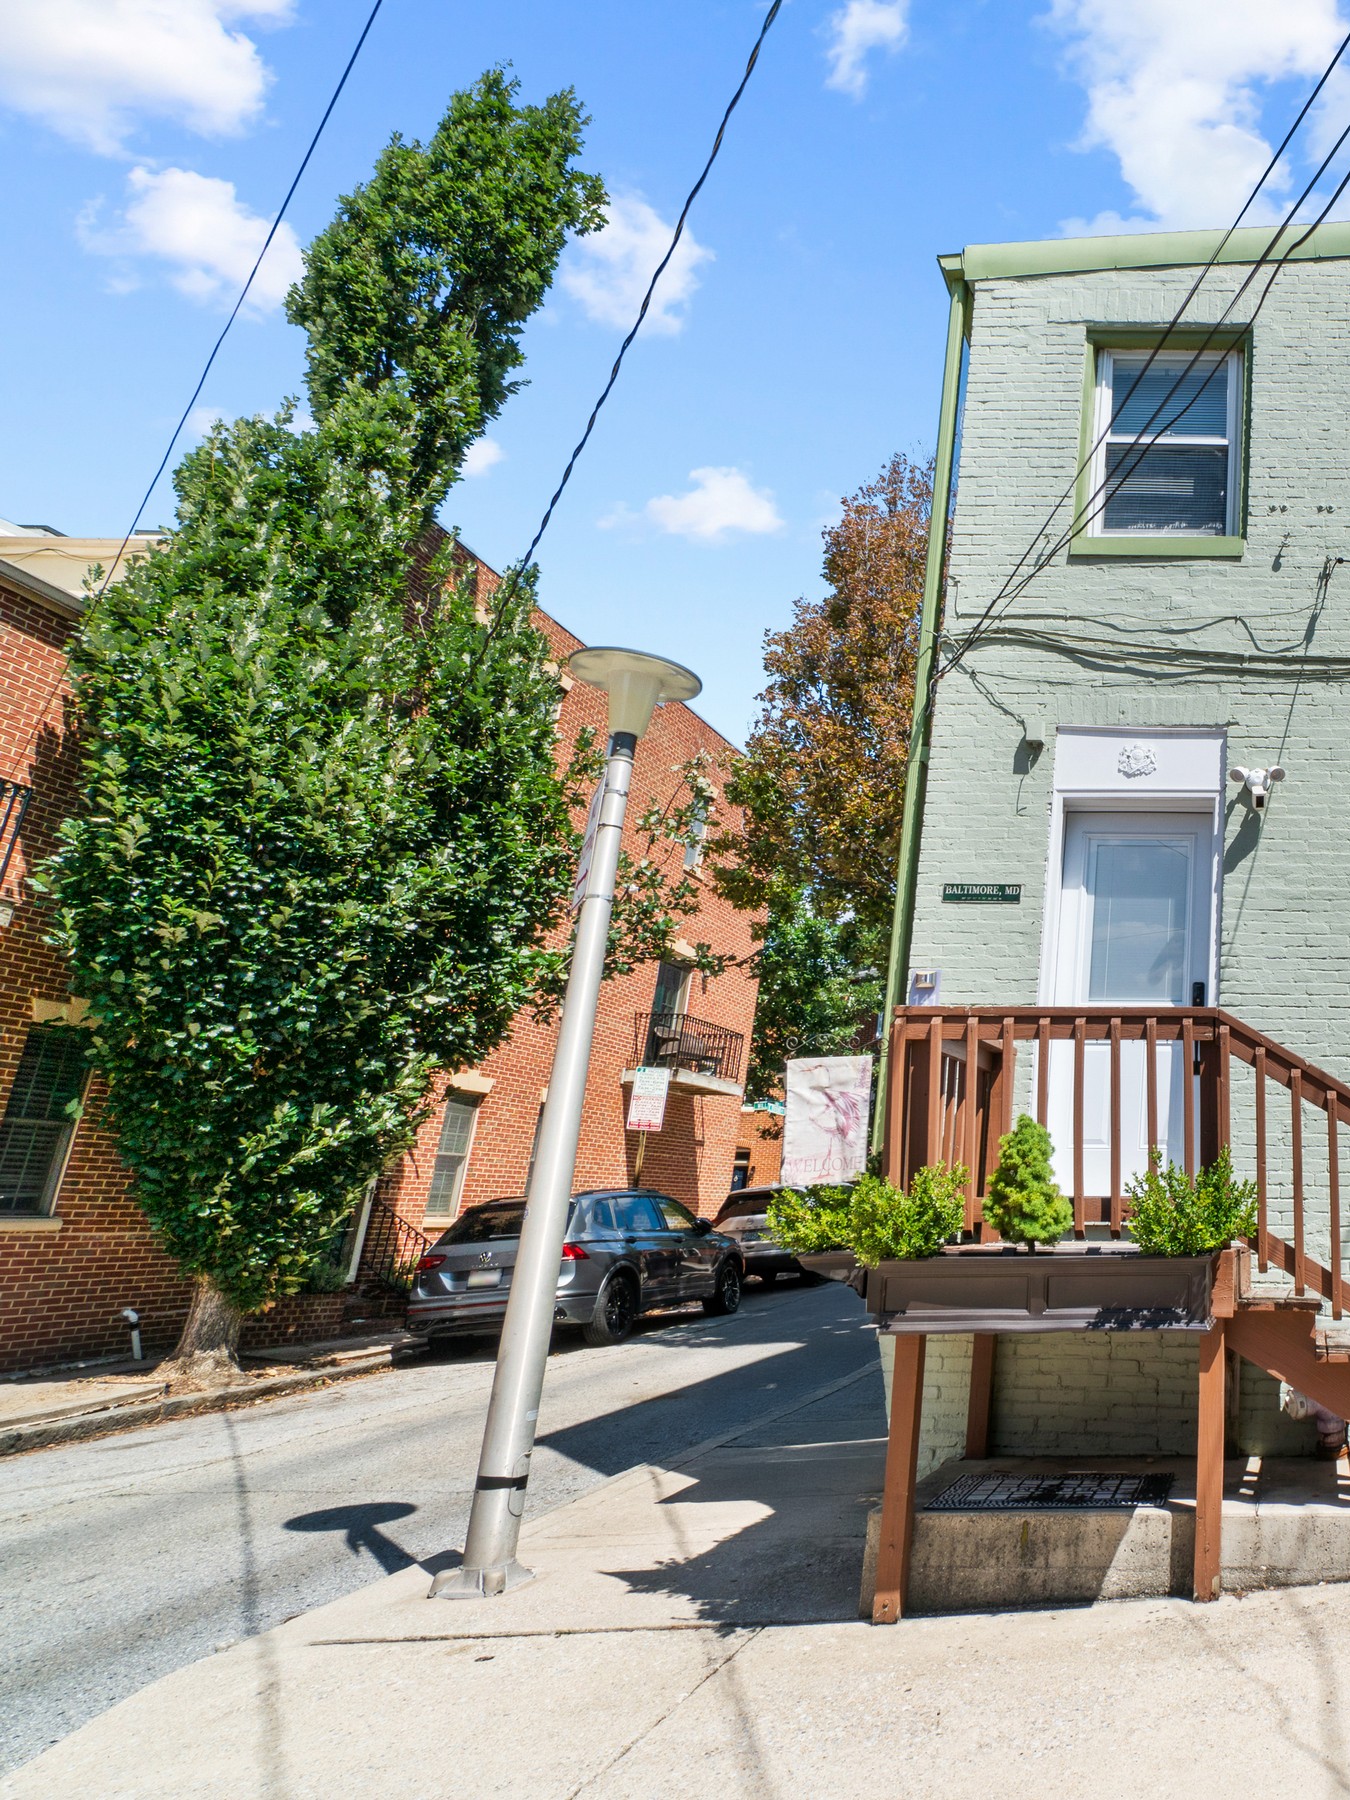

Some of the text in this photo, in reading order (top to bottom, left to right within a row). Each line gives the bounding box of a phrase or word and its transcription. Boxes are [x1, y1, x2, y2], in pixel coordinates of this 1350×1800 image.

[945, 885, 1020, 896] BALTIMORE, MD
[786, 1156, 862, 1172] WELCOME
